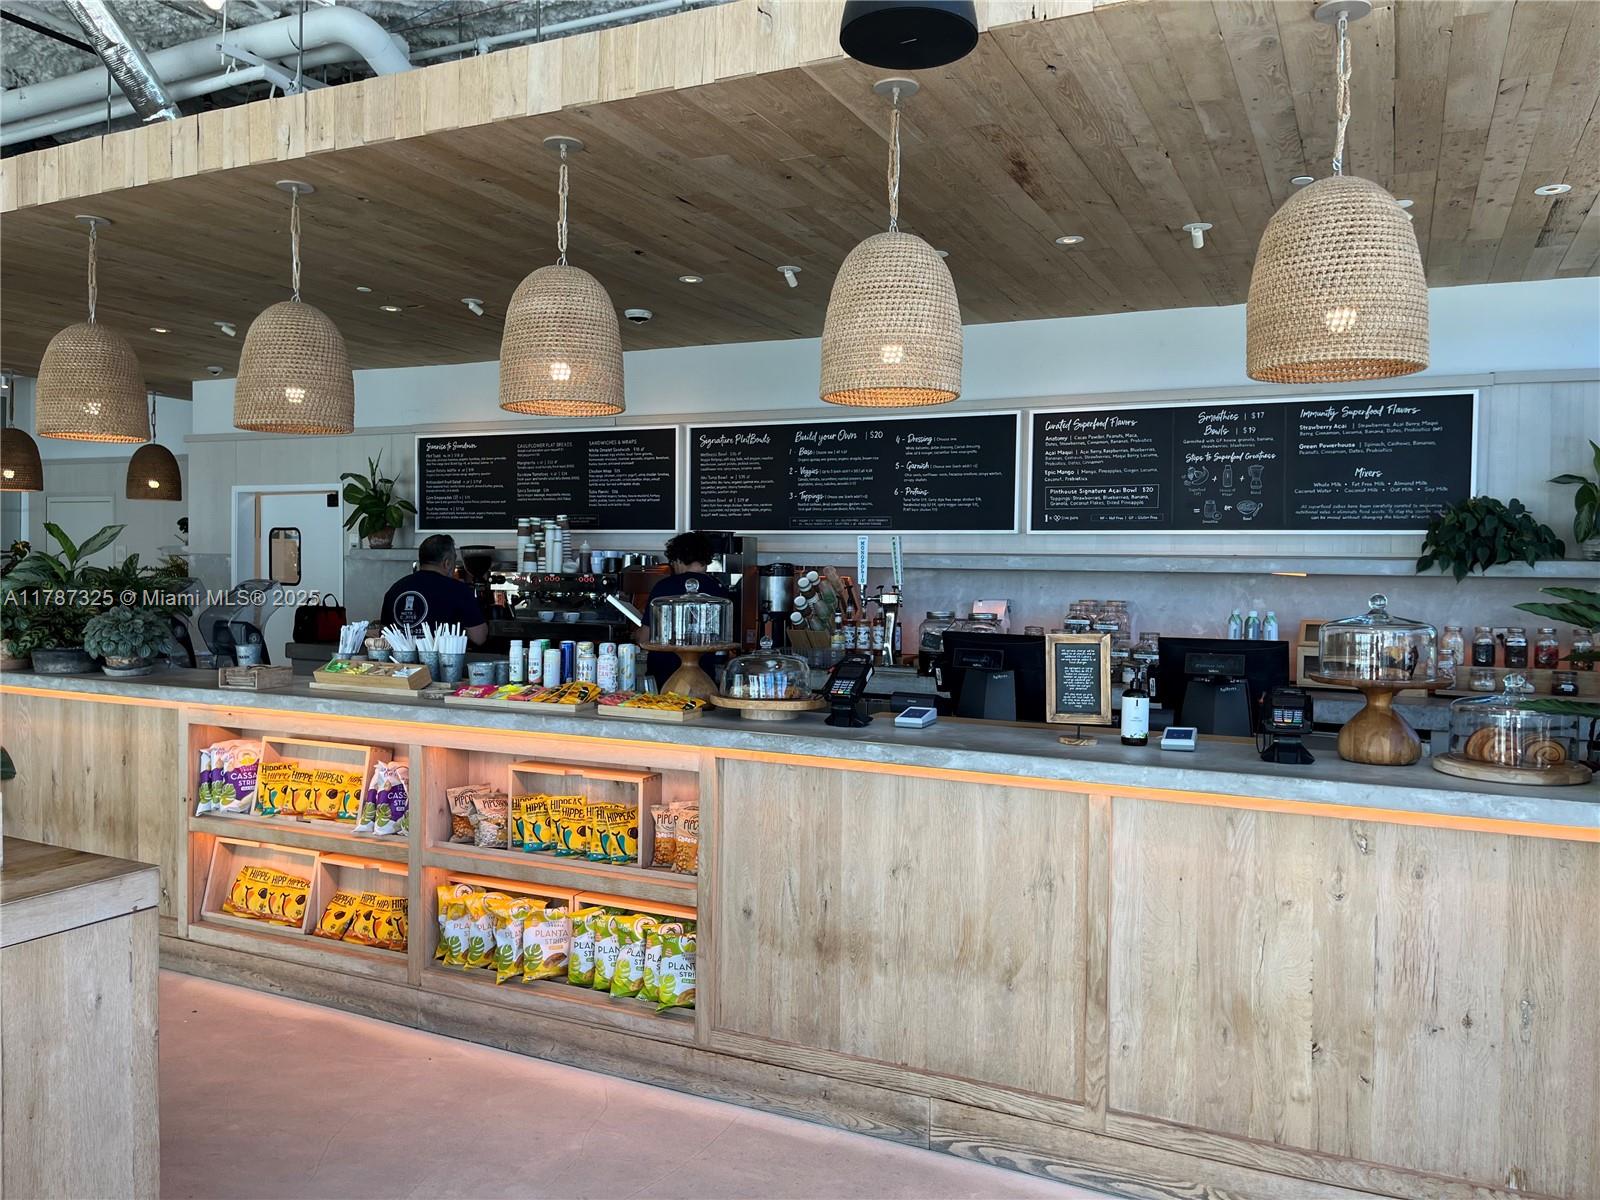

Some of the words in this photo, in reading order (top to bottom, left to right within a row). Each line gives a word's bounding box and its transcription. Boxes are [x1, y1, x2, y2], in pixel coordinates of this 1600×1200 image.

[1198, 409, 1240, 424] Smoothies
[1300, 406, 1339, 422] Immunity
[1341, 405, 1384, 420] Superfood
[1386, 404, 1421, 415] Flavors
[1045, 419, 1072, 431] Curated
[1110, 416, 1138, 427] Flavors
[1204, 425, 1229, 436] Bowls
[700, 434, 734, 449] Signature
[795, 431, 818, 443] Build
[817, 434, 837, 446] your
[837, 429, 858, 442] Own
[870, 431, 884, 439] $20
[907, 434, 933, 445] Dressing
[798, 447, 813, 456] Base
[1205, 452, 1212, 462] to
[789, 467, 793, 475] 2
[800, 466, 820, 477] Veggies
[906, 461, 929, 472] Garnish
[1354, 467, 1383, 479] Mixers
[789, 492, 794, 500] 3
[799, 491, 824, 503] Toppings
[894, 488, 899, 496] 6
[905, 487, 929, 496] Proteins
[315, 771, 344, 784] HIPPEAS
[607, 810, 636, 823] HIPPEAS
[535, 930, 569, 938] PLANTA
[544, 937, 568, 945] STRIPS
